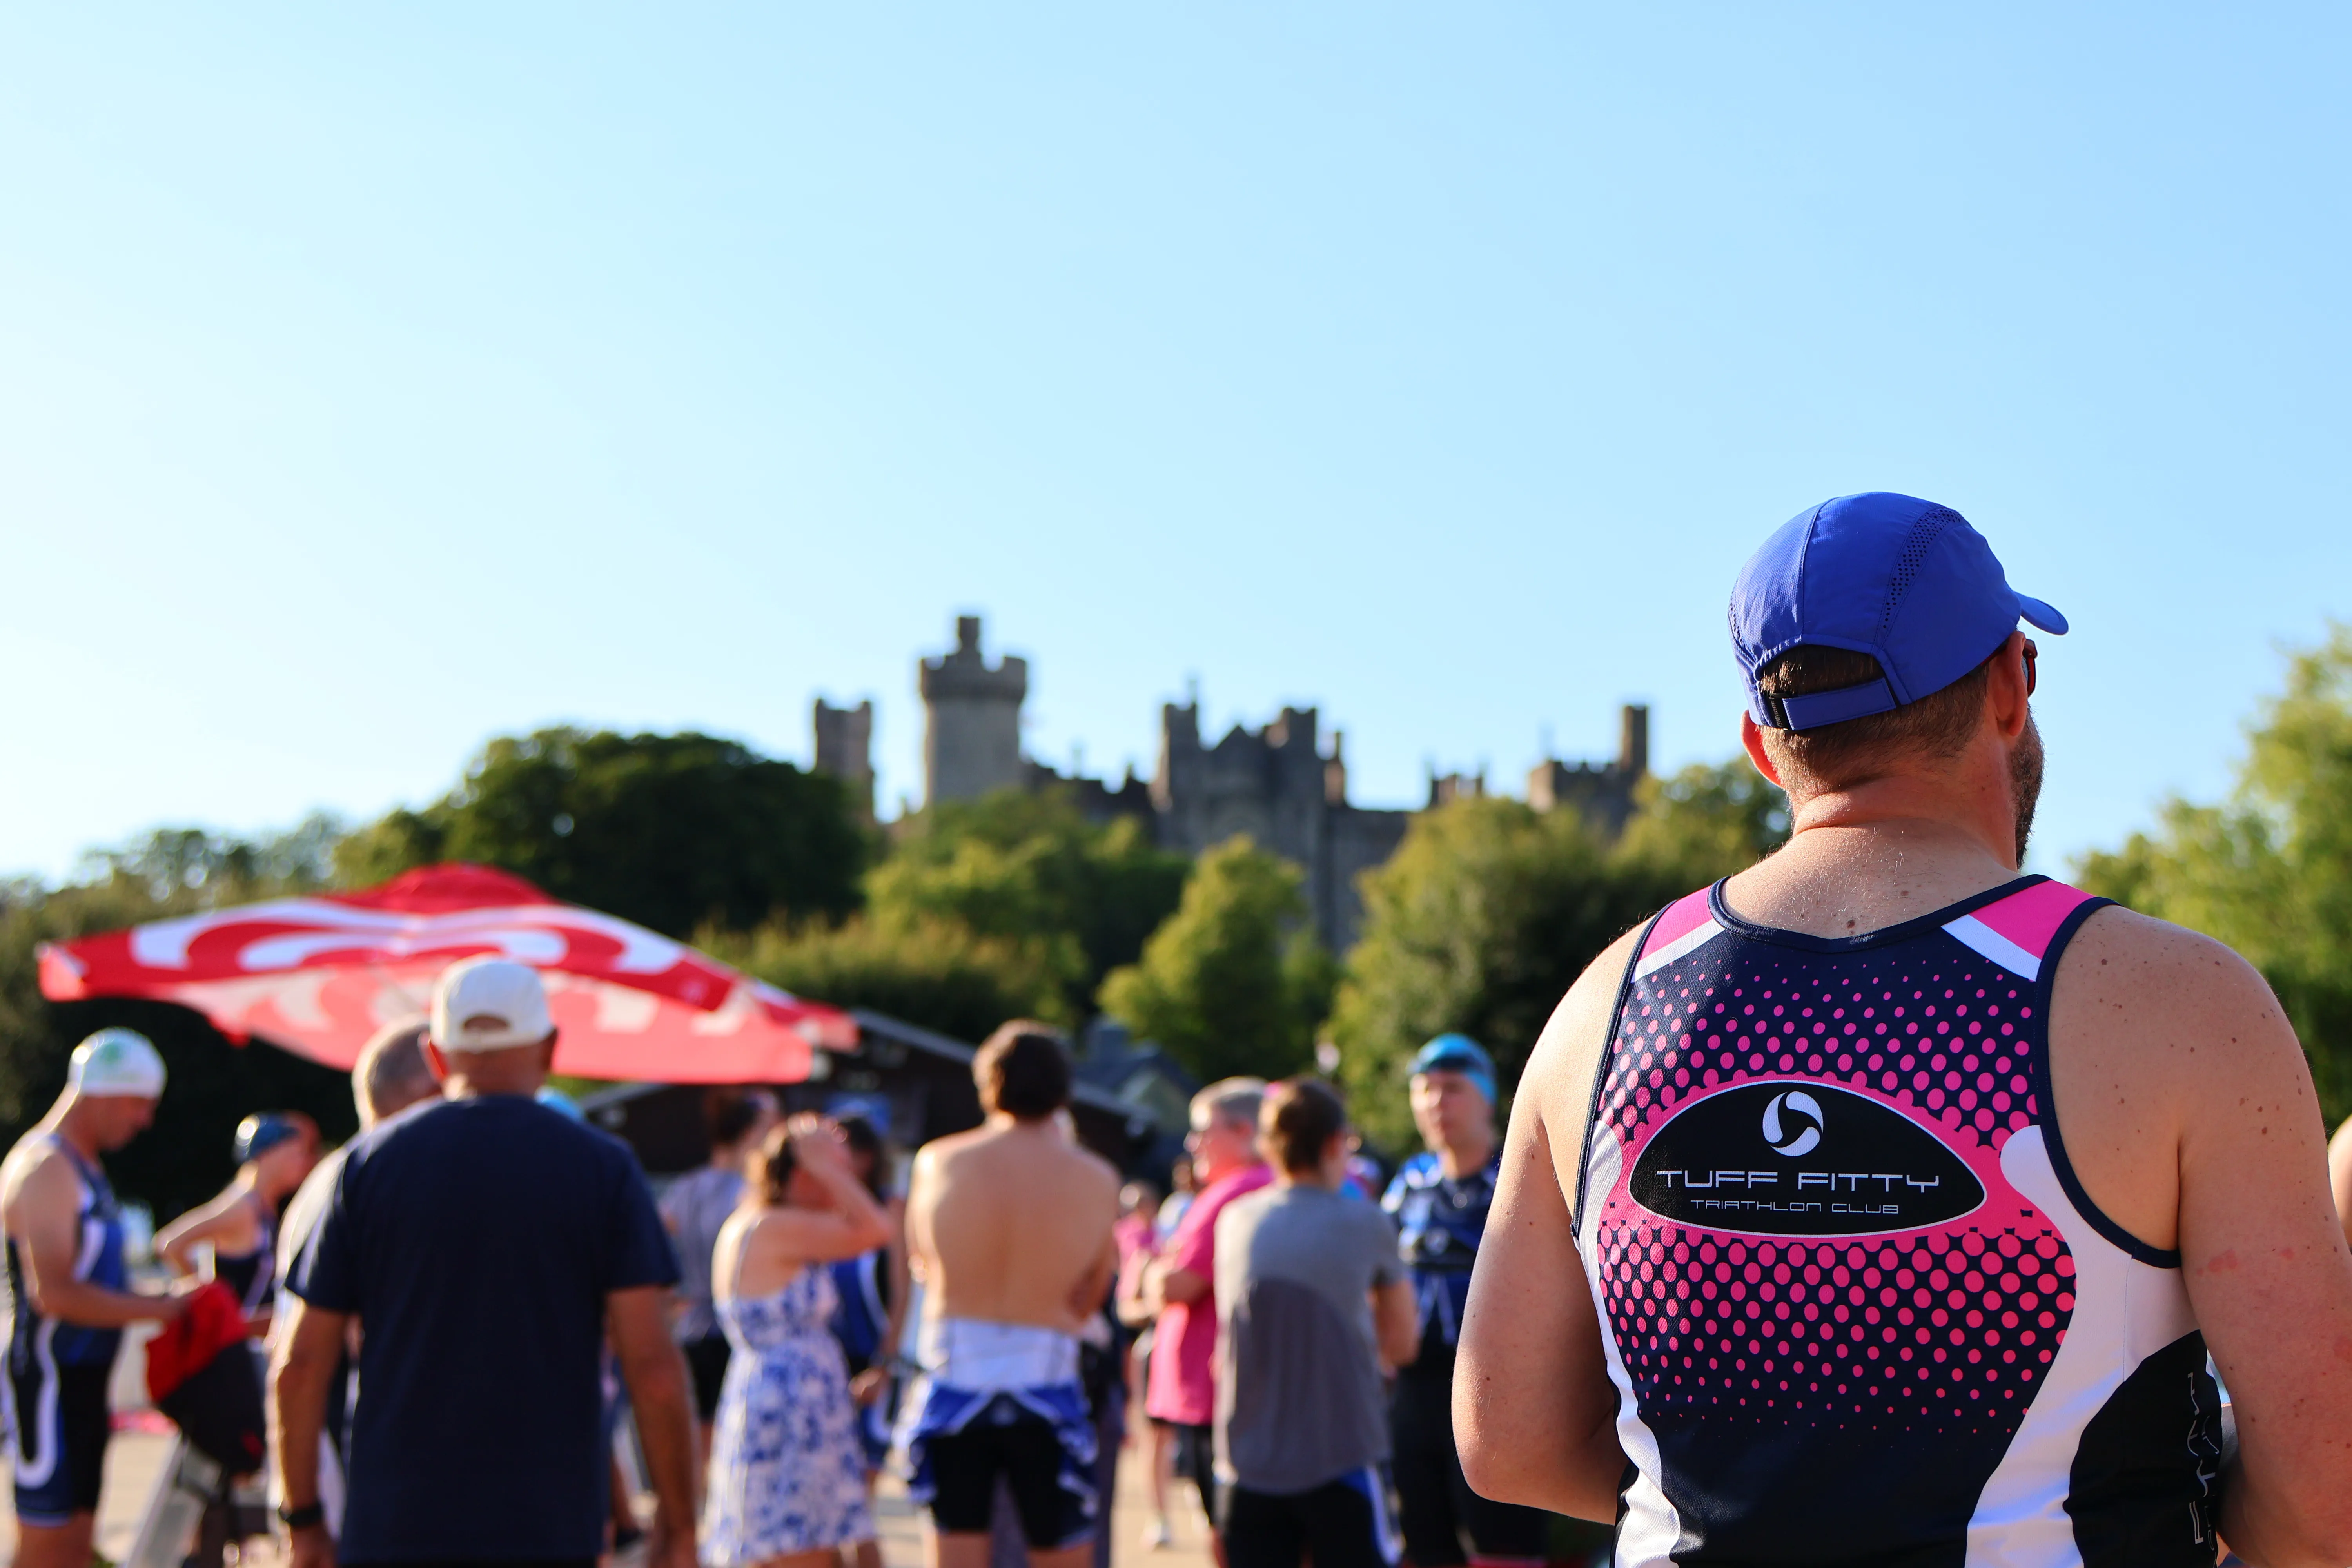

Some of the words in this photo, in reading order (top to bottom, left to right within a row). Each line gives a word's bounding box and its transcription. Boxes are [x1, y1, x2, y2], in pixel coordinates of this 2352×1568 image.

[1656, 1169, 1778, 1189] TUFF
[1798, 1172, 1939, 1193] FITTY
[1690, 1200, 1822, 1212] TRIATHLON
[1831, 1203, 1899, 1214] CLUB
